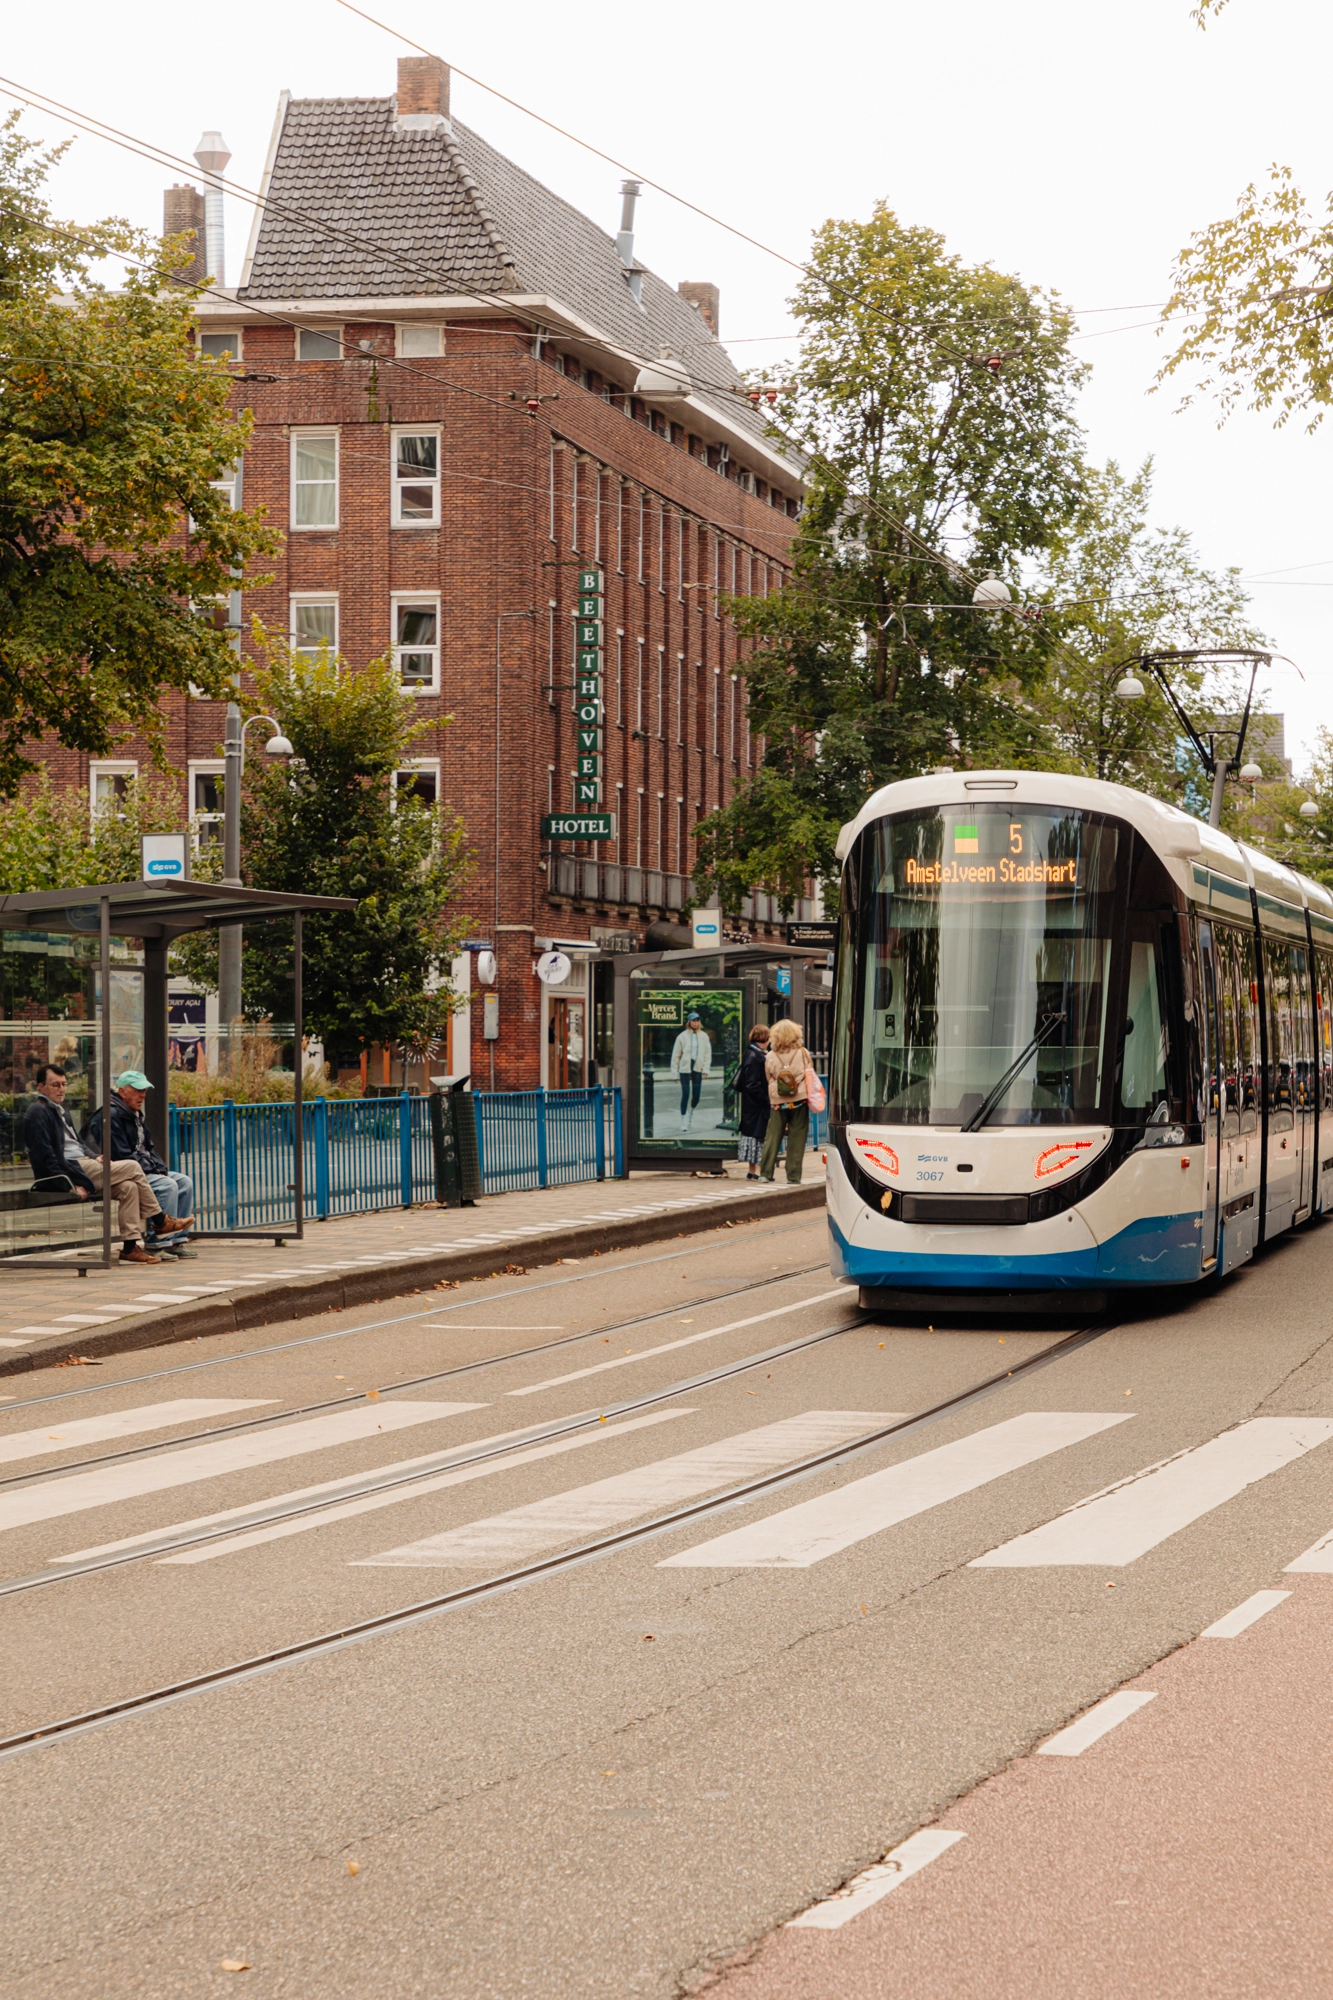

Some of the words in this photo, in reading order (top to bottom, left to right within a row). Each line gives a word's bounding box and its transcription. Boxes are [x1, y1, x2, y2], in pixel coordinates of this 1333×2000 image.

[580, 574, 597, 800] BEETHOVEN
[550, 820, 609, 834] HOTEL
[1009, 823, 1023, 854] 5
[906, 858, 996, 883] Amstelveen
[999, 857, 1077, 883] Stadshart
[615, 937, 622, 951] DE
[544, 966, 563, 975] BERRY
[781, 977, 790, 988] P
[648, 1003, 677, 1012] Mercer
[651, 1011, 678, 1020] Brand.
[916, 1171, 945, 1181] 3067
